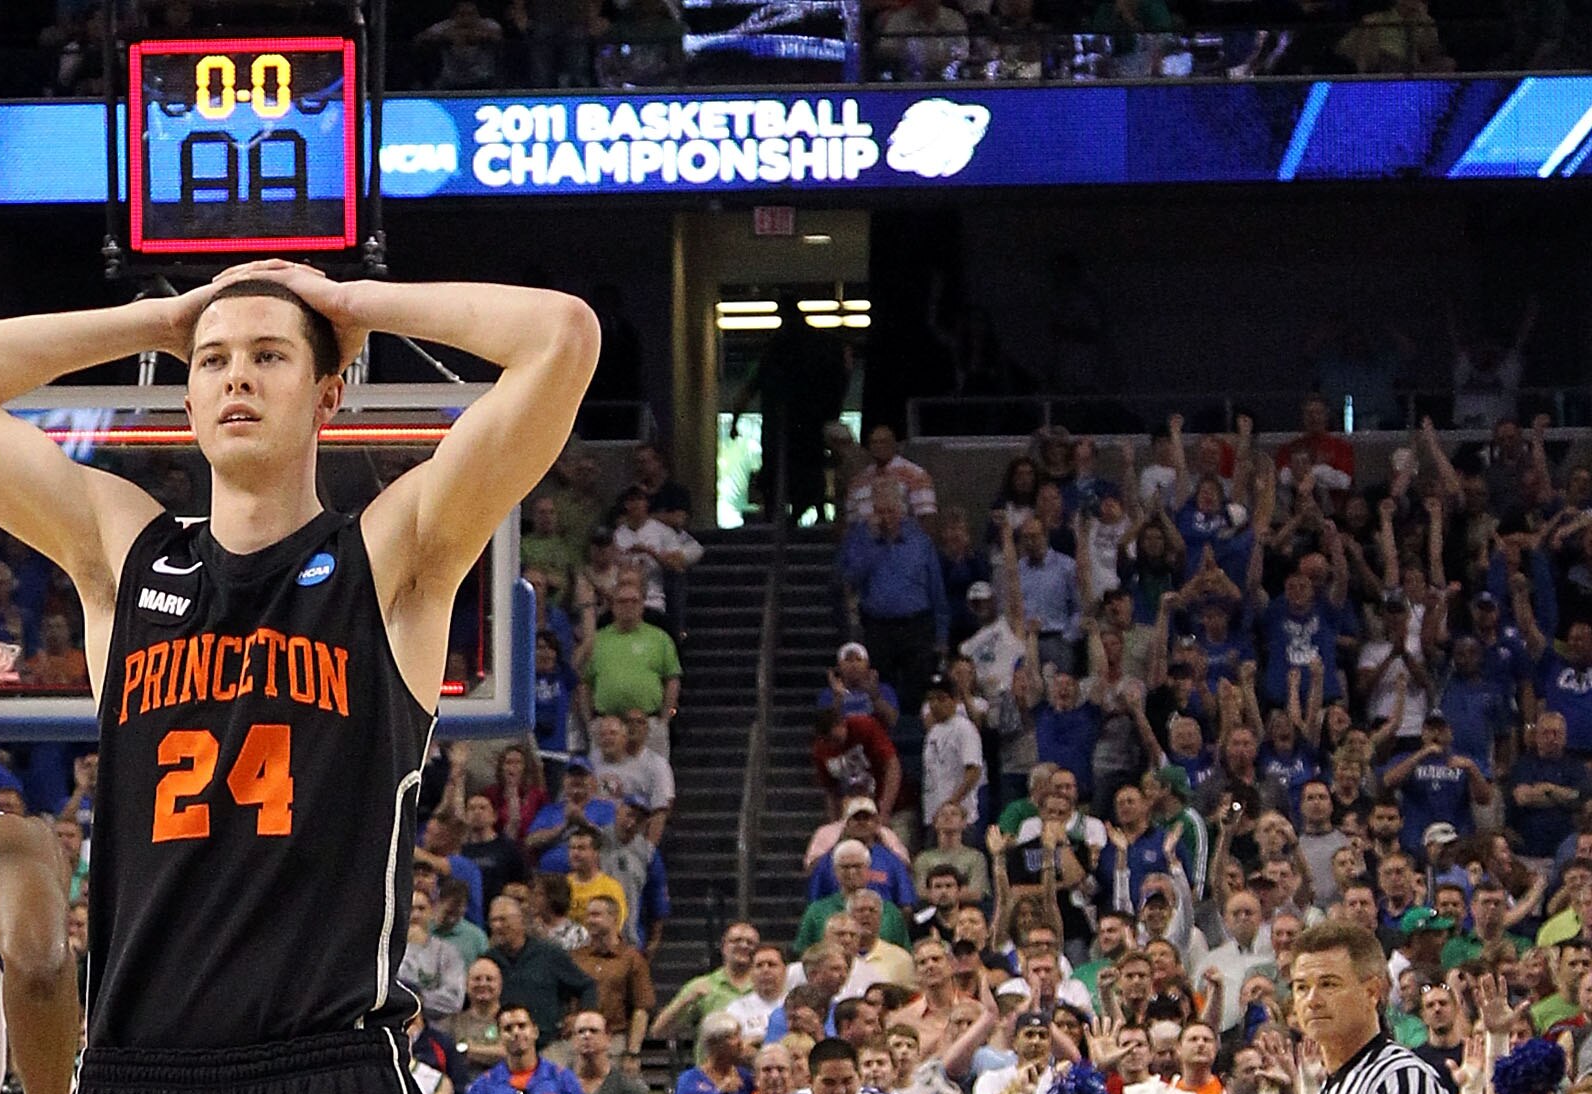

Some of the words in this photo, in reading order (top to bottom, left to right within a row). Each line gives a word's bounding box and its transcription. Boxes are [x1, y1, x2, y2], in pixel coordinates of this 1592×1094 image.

[474, 104, 567, 143] 2011
[576, 99, 873, 141] BASKETBALL
[473, 137, 879, 186] CHAMPIONSHIP
[138, 587, 191, 617] MARV
[118, 627, 350, 726] PRINCETON
[152, 724, 294, 843] 24
